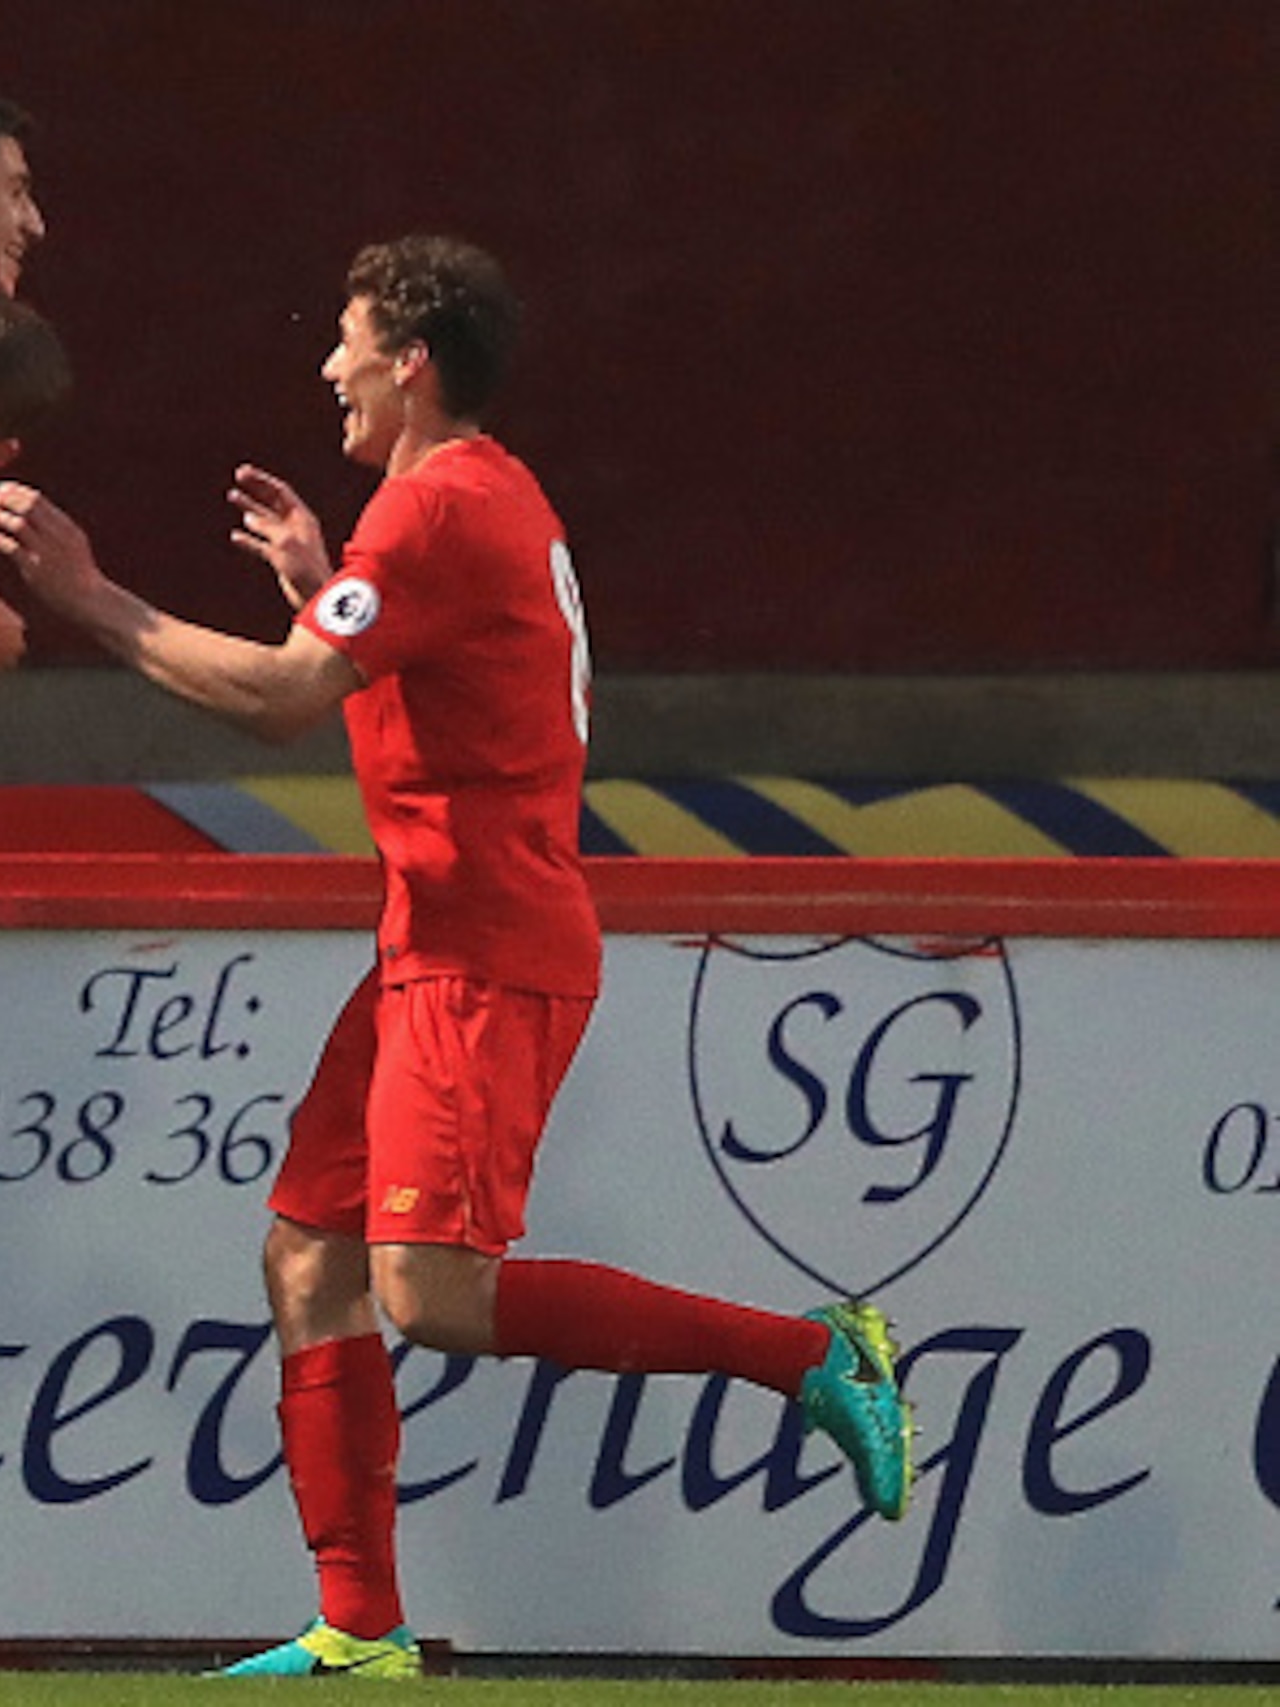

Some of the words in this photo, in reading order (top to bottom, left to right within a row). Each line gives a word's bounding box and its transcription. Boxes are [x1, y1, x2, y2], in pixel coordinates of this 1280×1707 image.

[80, 953, 262, 1061] Tel:
[142, 1093, 298, 1186] 36
[720, 991, 983, 1204] SG
